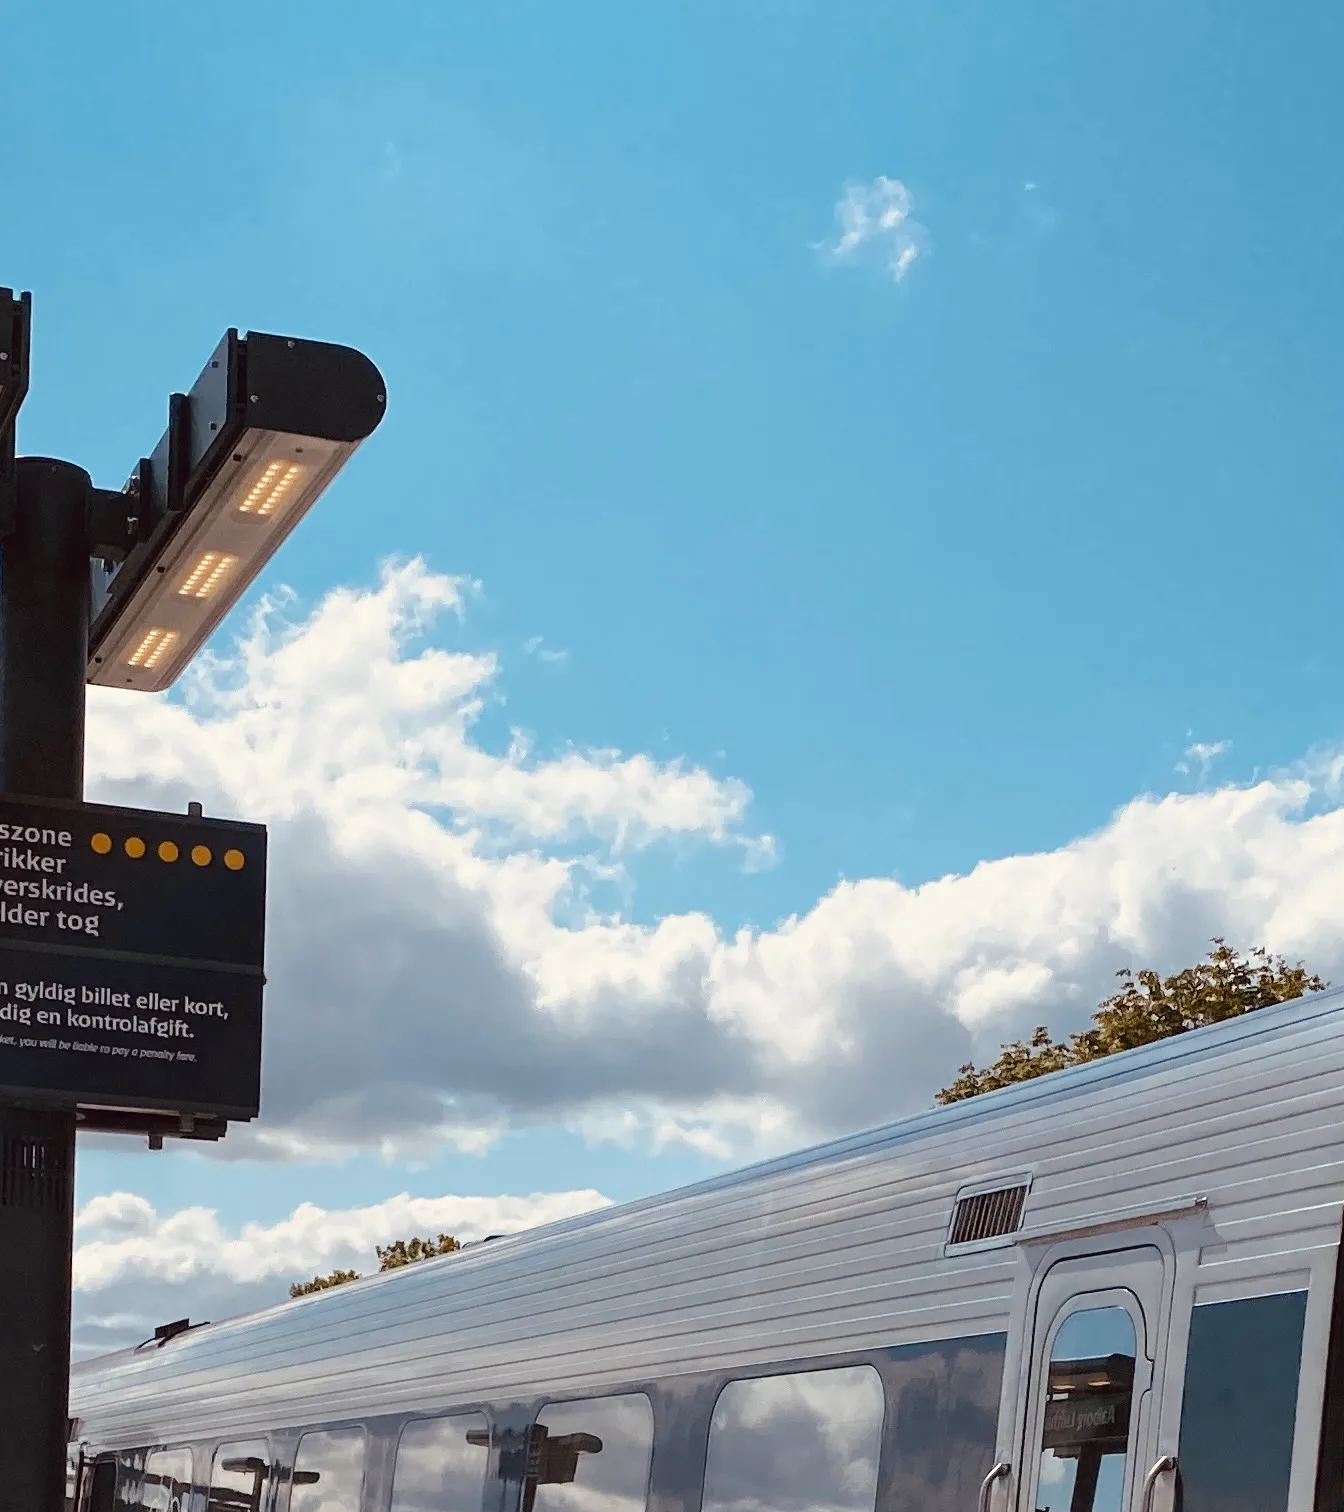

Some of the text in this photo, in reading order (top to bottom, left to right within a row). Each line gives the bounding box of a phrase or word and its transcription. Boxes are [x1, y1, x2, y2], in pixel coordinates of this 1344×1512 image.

[56, 910, 99, 936] tog
[14, 981, 76, 1006] gyldig
[81, 986, 131, 1008] billet
[136, 992, 180, 1012] eller
[184, 996, 229, 1020] kort,
[0, 1001, 32, 1026] dig
[36, 1009, 61, 1025] en
[67, 1009, 195, 1039] kontrolafgift.
[18, 1038, 38, 1048] you
[111, 1047, 131, 1058] pay
[139, 1048, 175, 1062] penalty
